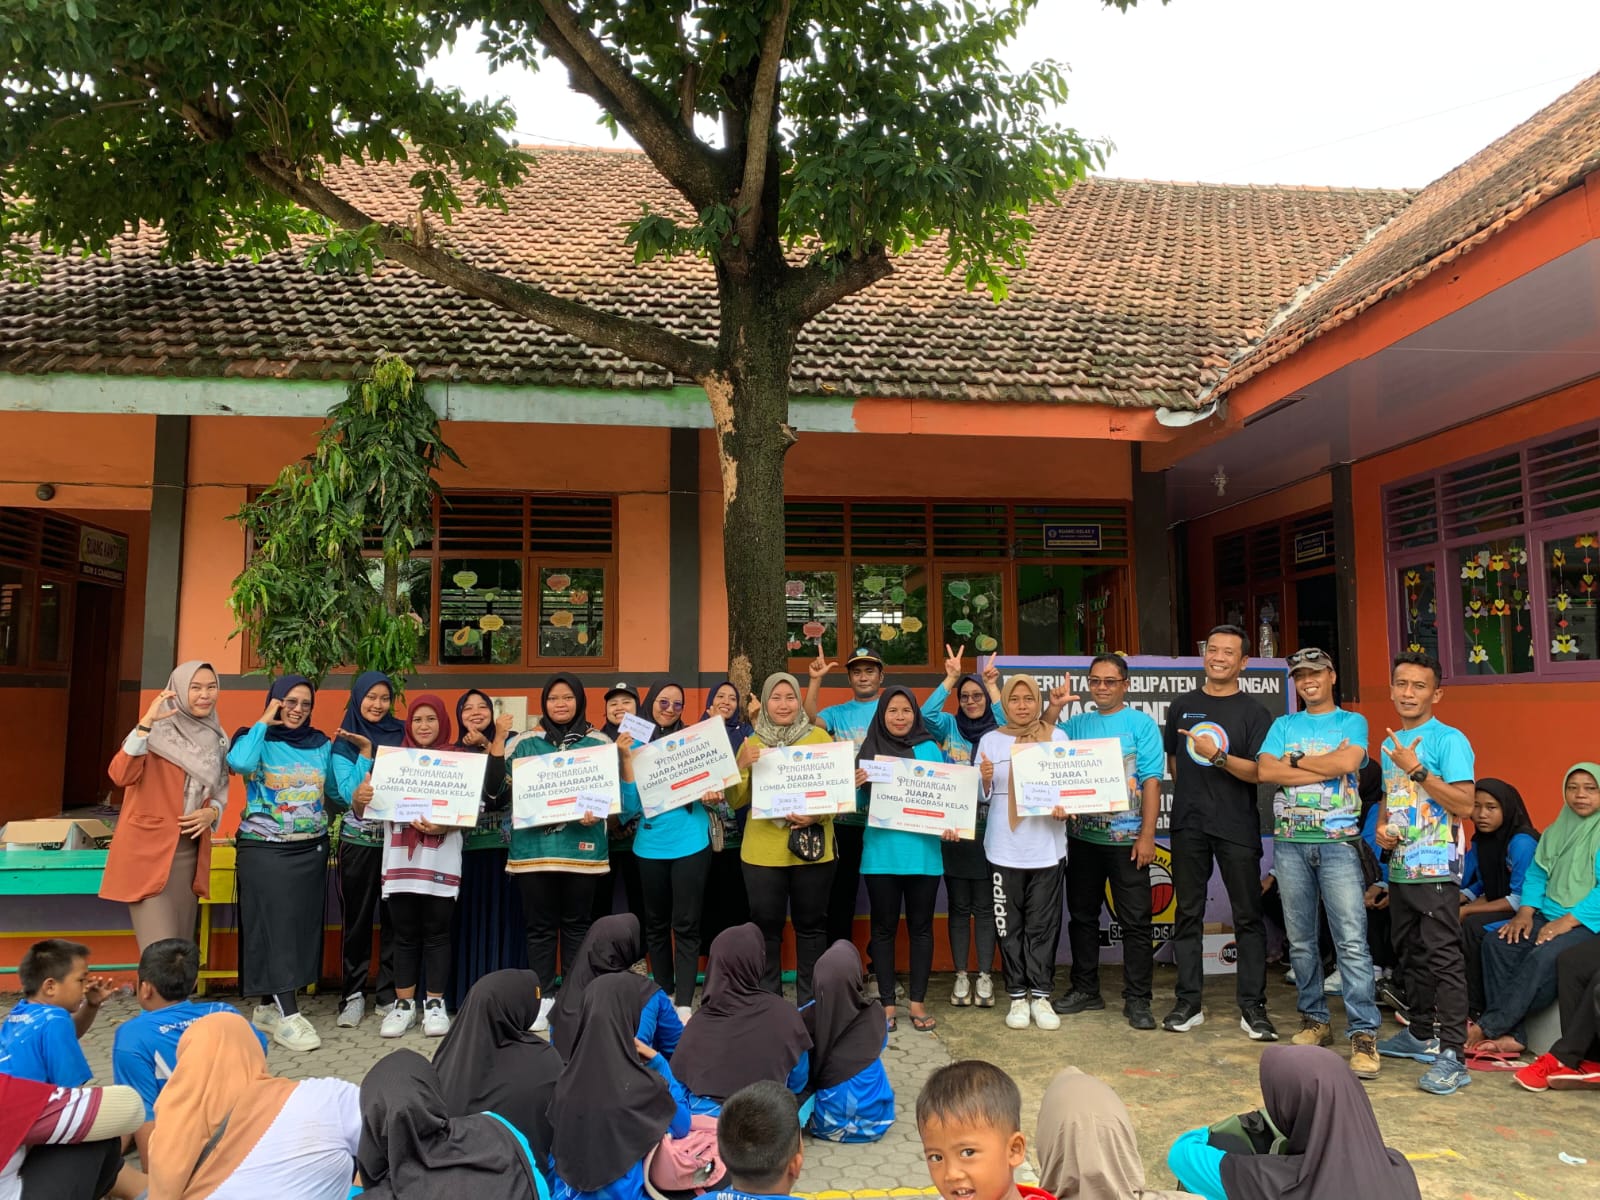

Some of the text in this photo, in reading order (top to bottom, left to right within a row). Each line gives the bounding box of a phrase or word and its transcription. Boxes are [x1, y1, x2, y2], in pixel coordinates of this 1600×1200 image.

[653, 740, 710, 768] PENGHARGAAN
[649, 748, 718, 780] JUARA HARAPAN
[777, 761, 835, 775] PENGHARGAAN
[1038, 759, 1103, 772] PENGHARGAAN
[400, 767, 464, 780] PENGHARGAAN
[537, 765, 598, 782] PENGHARGAAN
[642, 777, 668, 791] LOMBA
[669, 762, 705, 780] DEKORASI
[706, 753, 728, 766] KELAS
[786, 774, 815, 782] JUARA
[1050, 770, 1082, 779] JUARA
[386, 777, 467, 789] JUARA HARAPAN
[527, 774, 604, 792] JUARA HARAPAN
[759, 778, 849, 792] LOMBA DEKORASI KELAS
[896, 776, 957, 792] PENGHARGAAN
[1051, 778, 1092, 787] DEKORASI
[1094, 776, 1120, 784] KELAS
[406, 786, 448, 796] DEKORASI
[450, 789, 475, 797] KELAS
[518, 781, 614, 800] LOMBA DEKORASI KELAS
[905, 789, 934, 799] JUARA
[876, 793, 969, 811] LOMBA DEKORASI KELAS
[993, 872, 1007, 937] adidas
